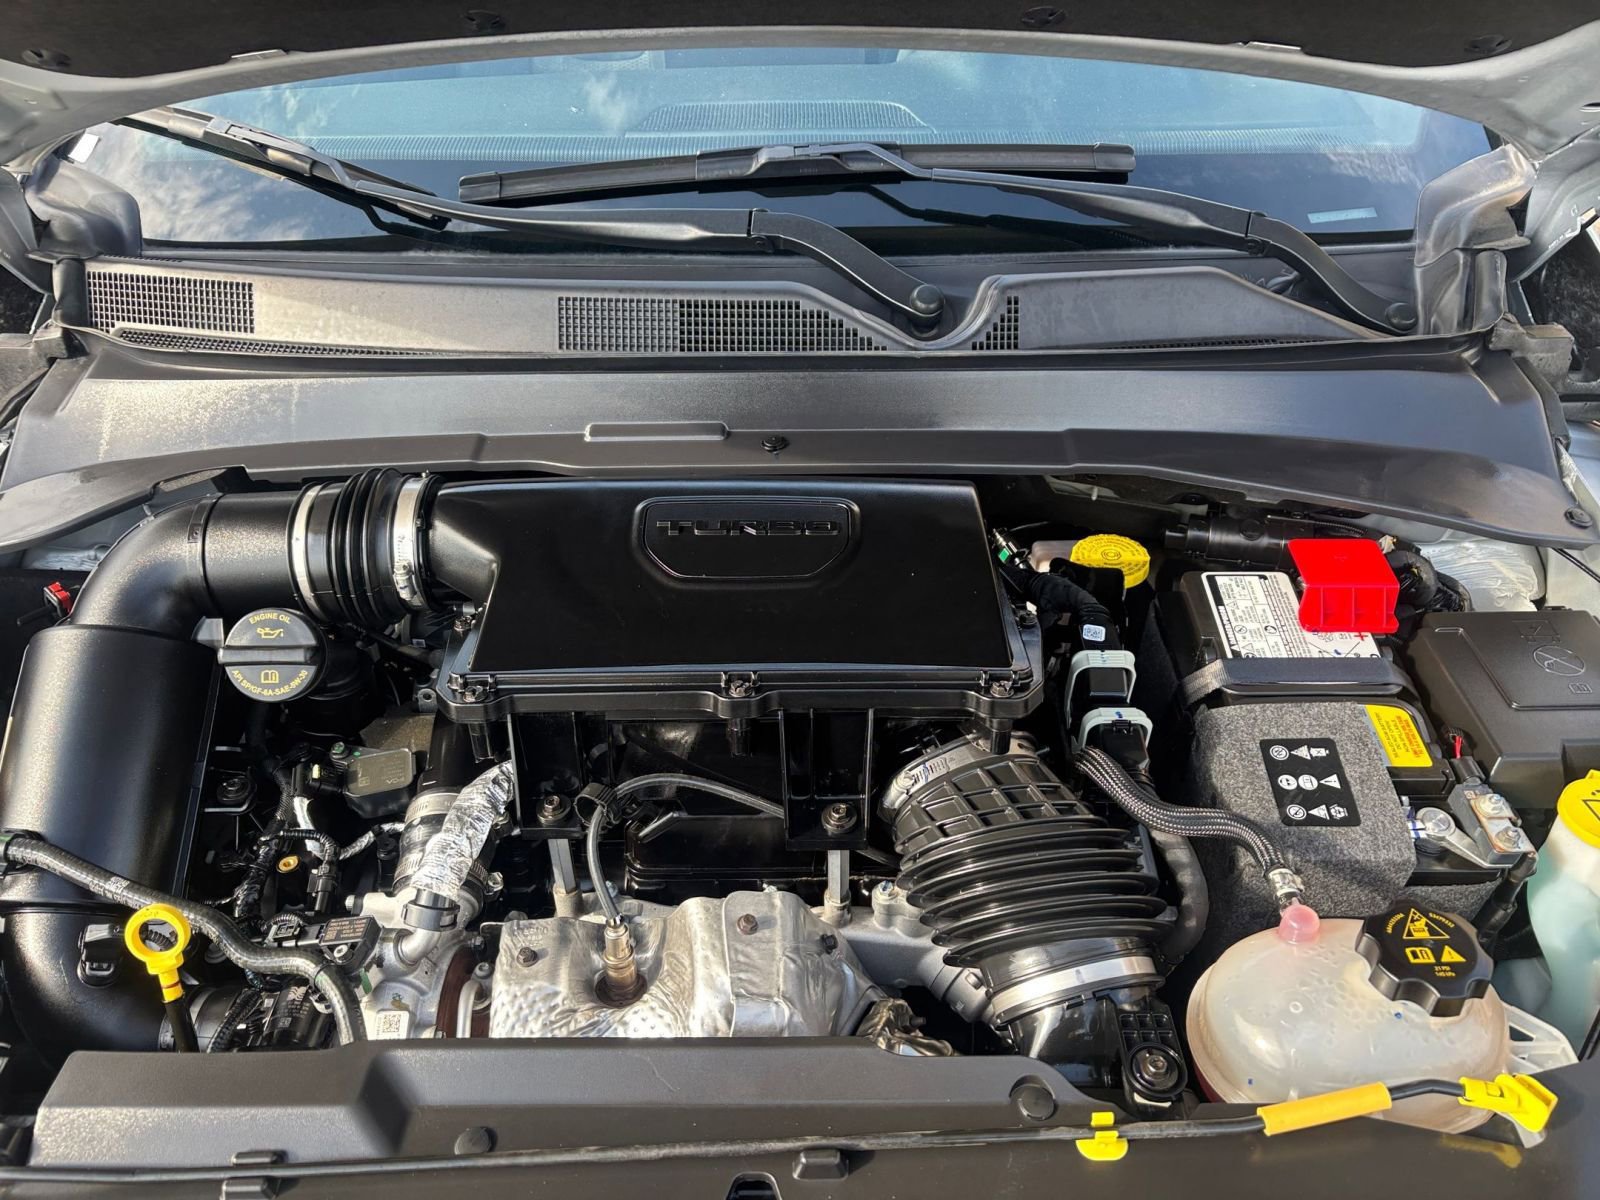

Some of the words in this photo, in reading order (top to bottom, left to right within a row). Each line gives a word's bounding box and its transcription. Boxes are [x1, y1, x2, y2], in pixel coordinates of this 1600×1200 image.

[656, 521, 840, 536] TURBO
[248, 612, 278, 625] ENGINE
[278, 614, 292, 625] OIL
[231, 669, 243, 683] API
